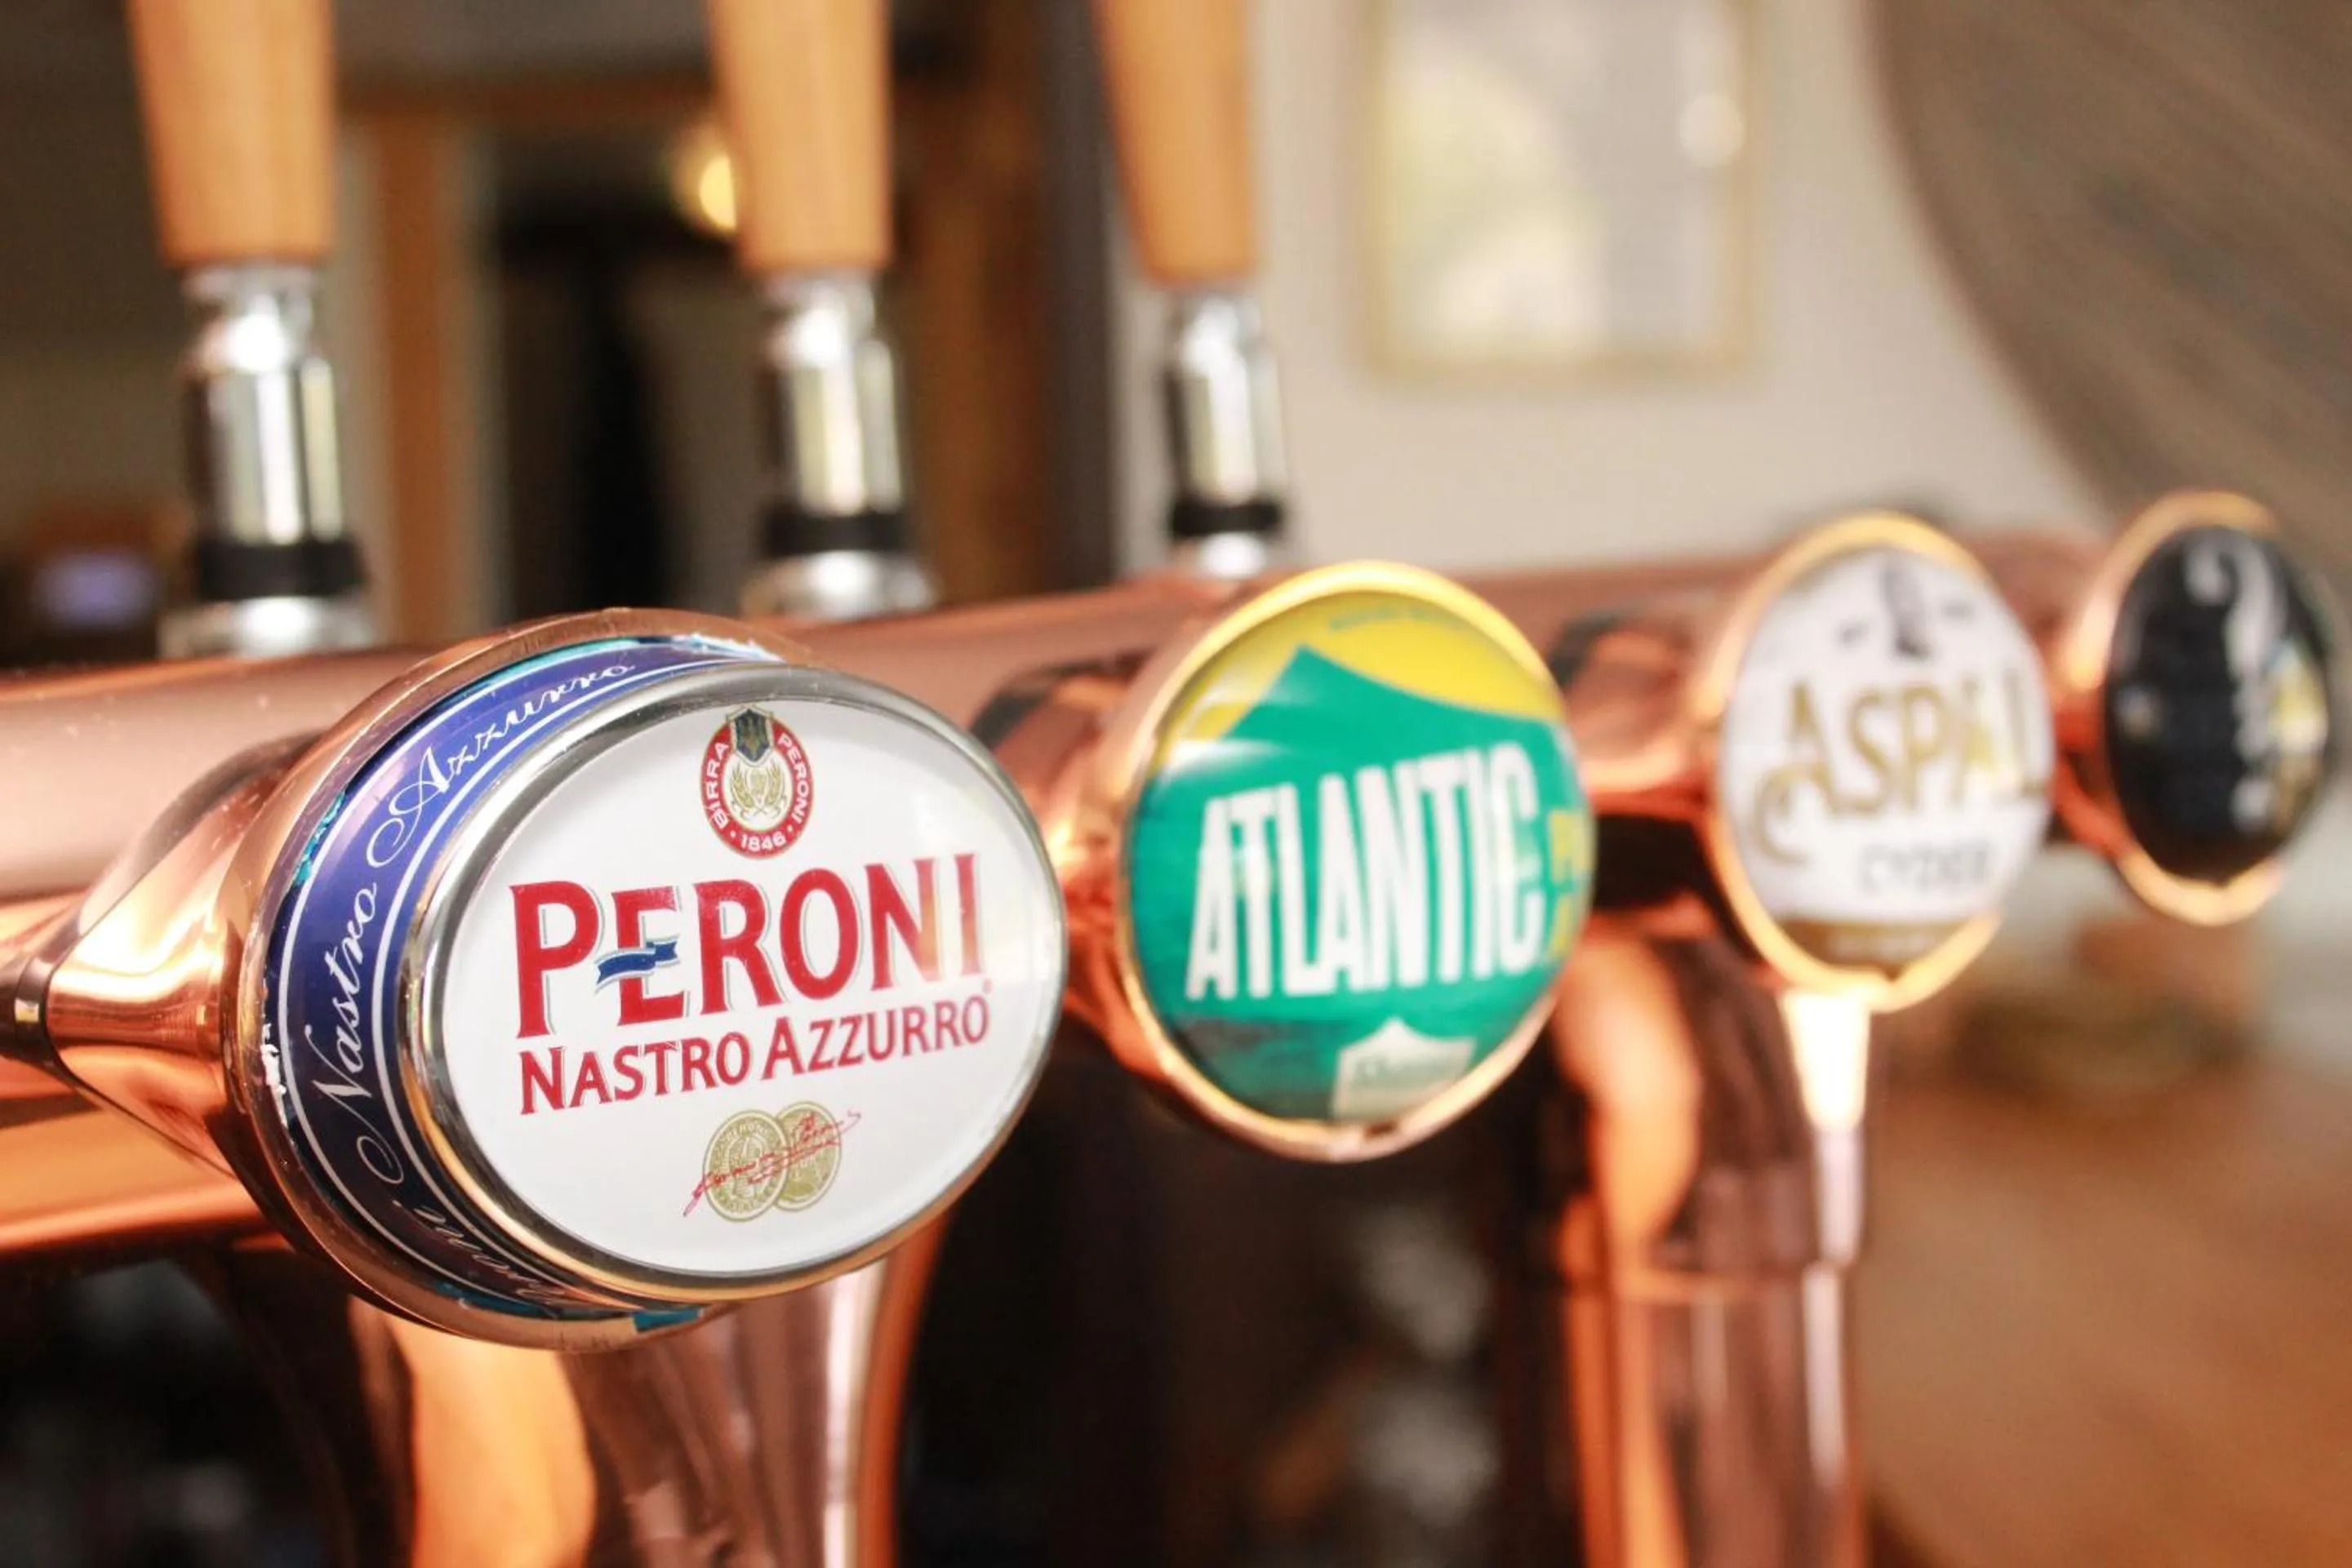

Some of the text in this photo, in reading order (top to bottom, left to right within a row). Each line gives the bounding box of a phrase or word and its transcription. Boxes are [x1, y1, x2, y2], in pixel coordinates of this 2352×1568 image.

[705, 732, 810, 829] BIRRA PERONI
[740, 831, 787, 852] 1846
[305, 664, 636, 1184] Nastro Azzurro
[509, 853, 983, 1039] PERONI
[1185, 741, 1548, 1001] ATLANTIC
[519, 993, 990, 1115] NASTRO AZZURRO
